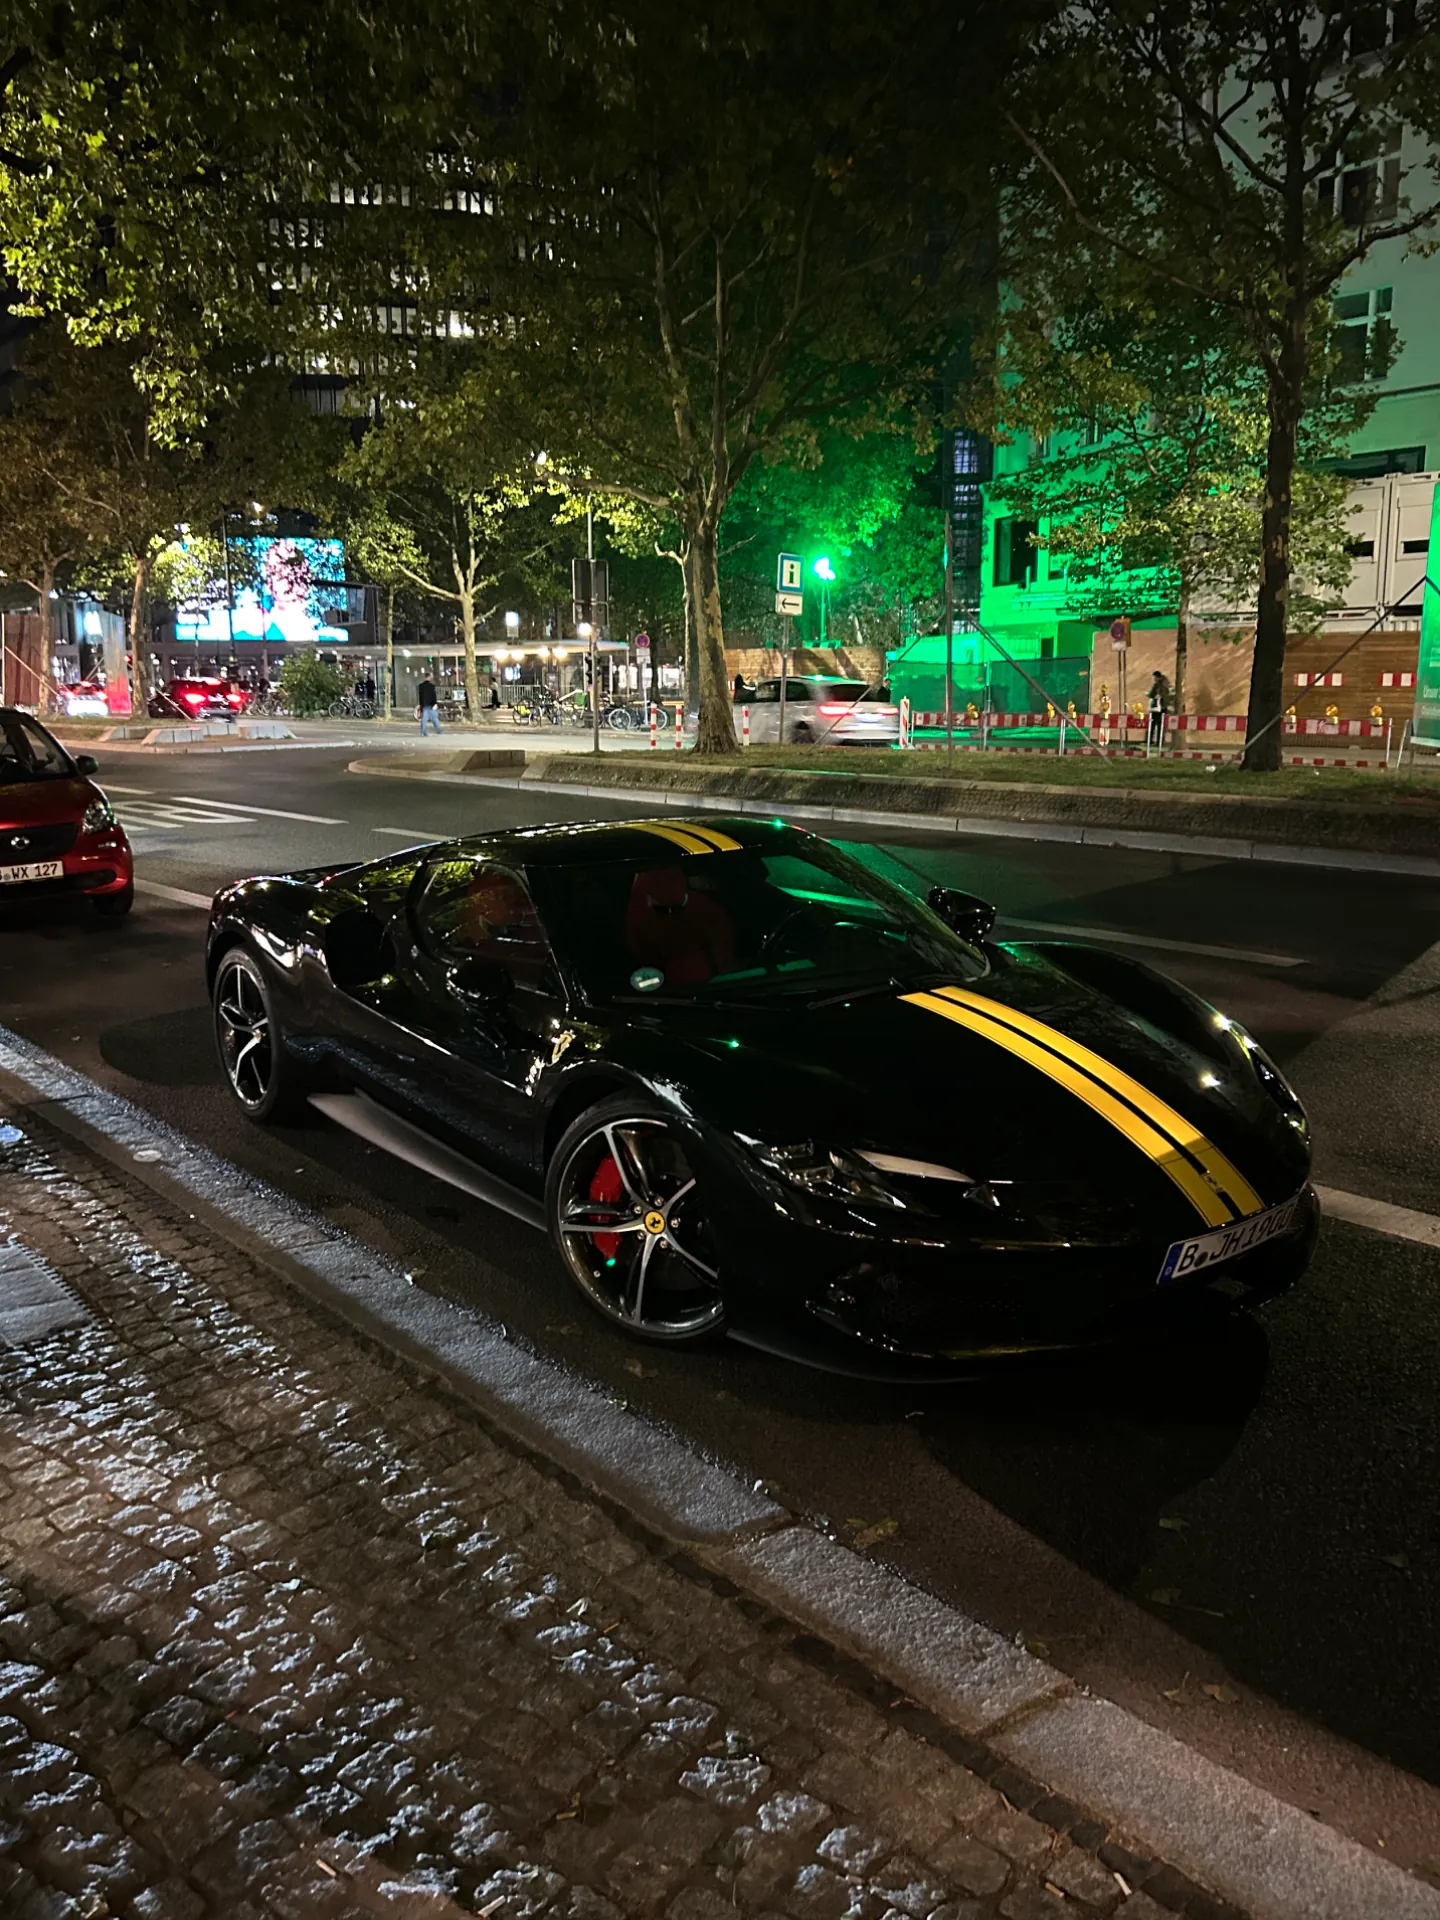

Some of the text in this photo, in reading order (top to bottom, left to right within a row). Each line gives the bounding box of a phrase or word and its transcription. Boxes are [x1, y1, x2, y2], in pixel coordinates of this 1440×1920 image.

[11, 867, 29, 880] WX
[34, 863, 58, 877] 127
[1177, 1243, 1199, 1272] B
[1241, 1203, 1294, 1249] 1900
